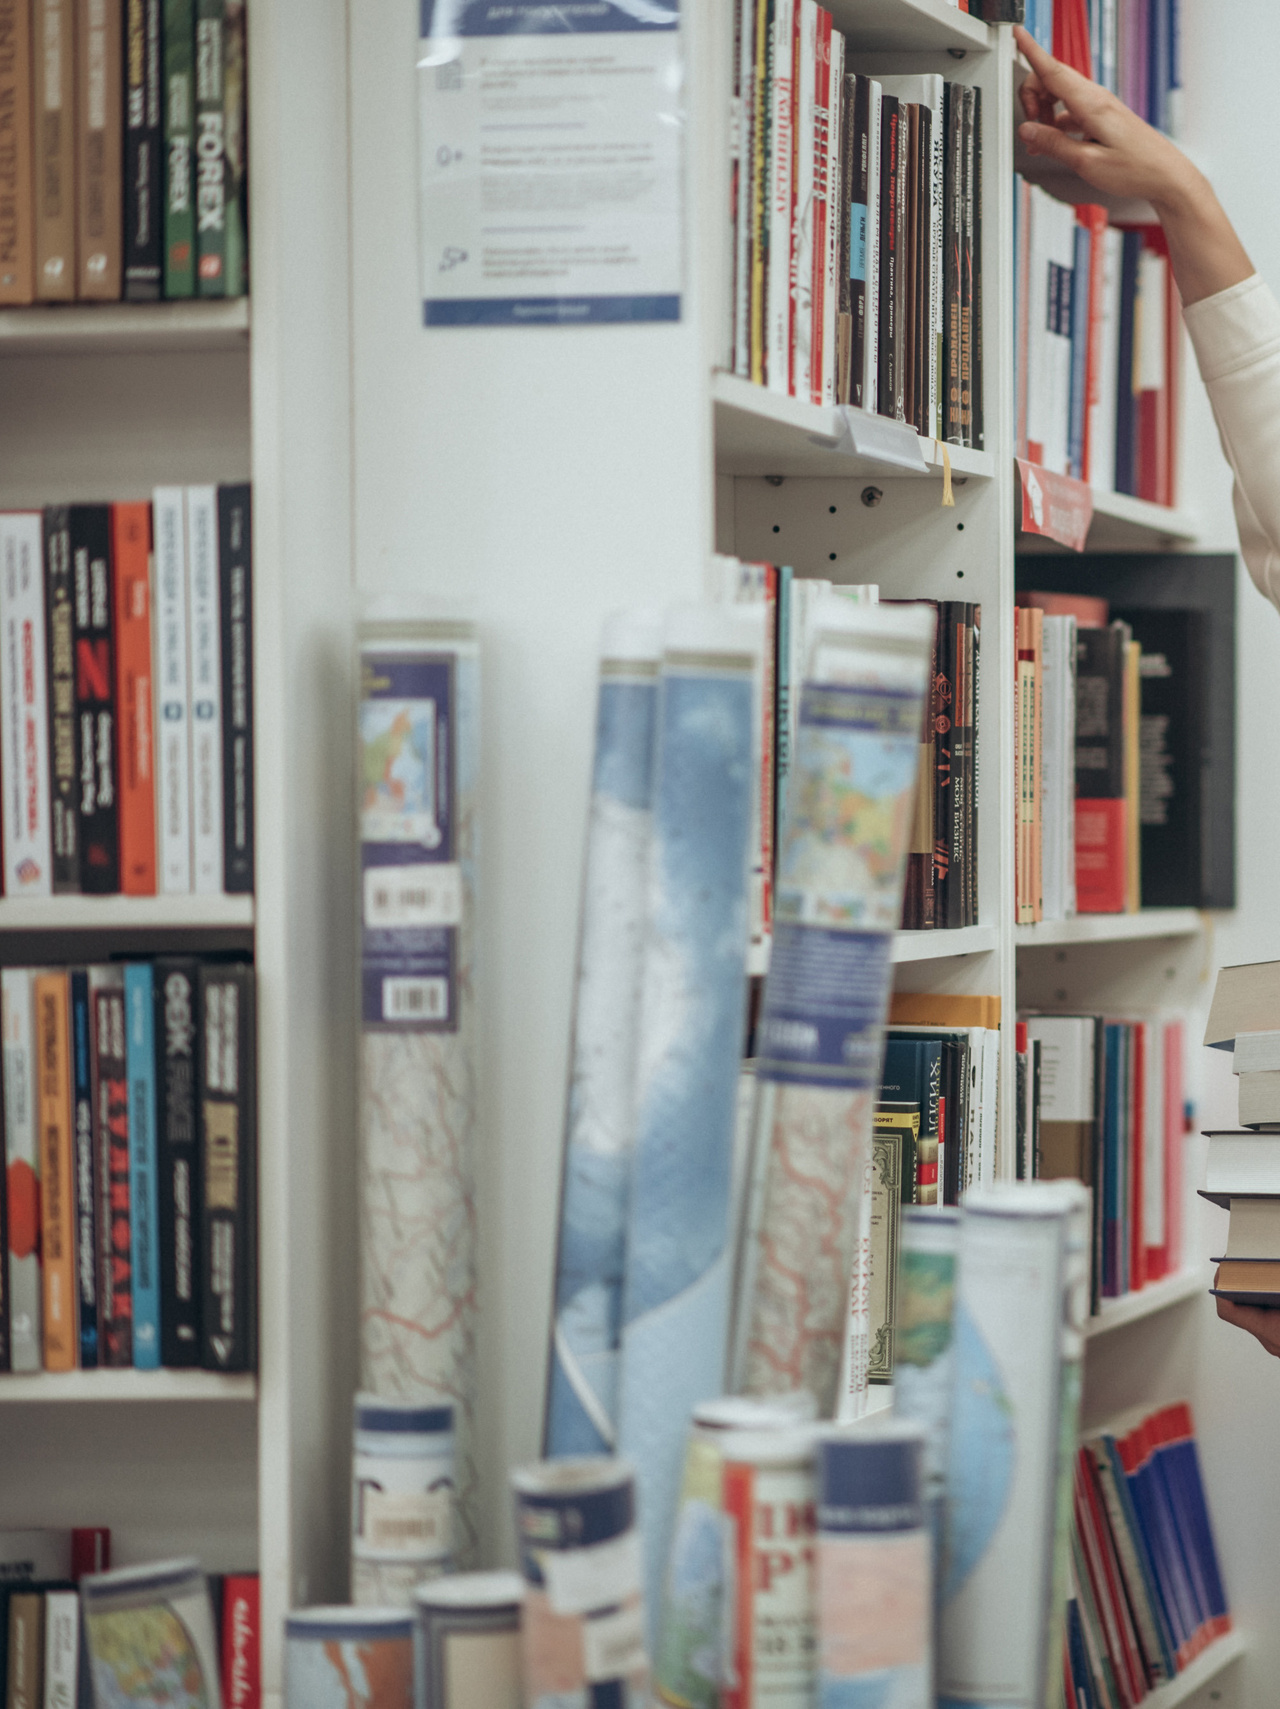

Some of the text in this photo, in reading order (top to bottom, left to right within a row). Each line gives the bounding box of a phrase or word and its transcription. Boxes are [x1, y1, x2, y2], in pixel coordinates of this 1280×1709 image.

[170, 135, 190, 213] FOREX
[197, 112, 225, 231] FOREX
[889, 113, 898, 173] Продажи,
[888, 176, 896, 251] переговоры
[950, 303, 959, 377] ПРОДАВЕЦ
[961, 307, 970, 380] ПРОДАВЕЦ
[953, 777, 961, 807] МОЙ
[929, 1061, 938, 1132] ХИЛЛ
